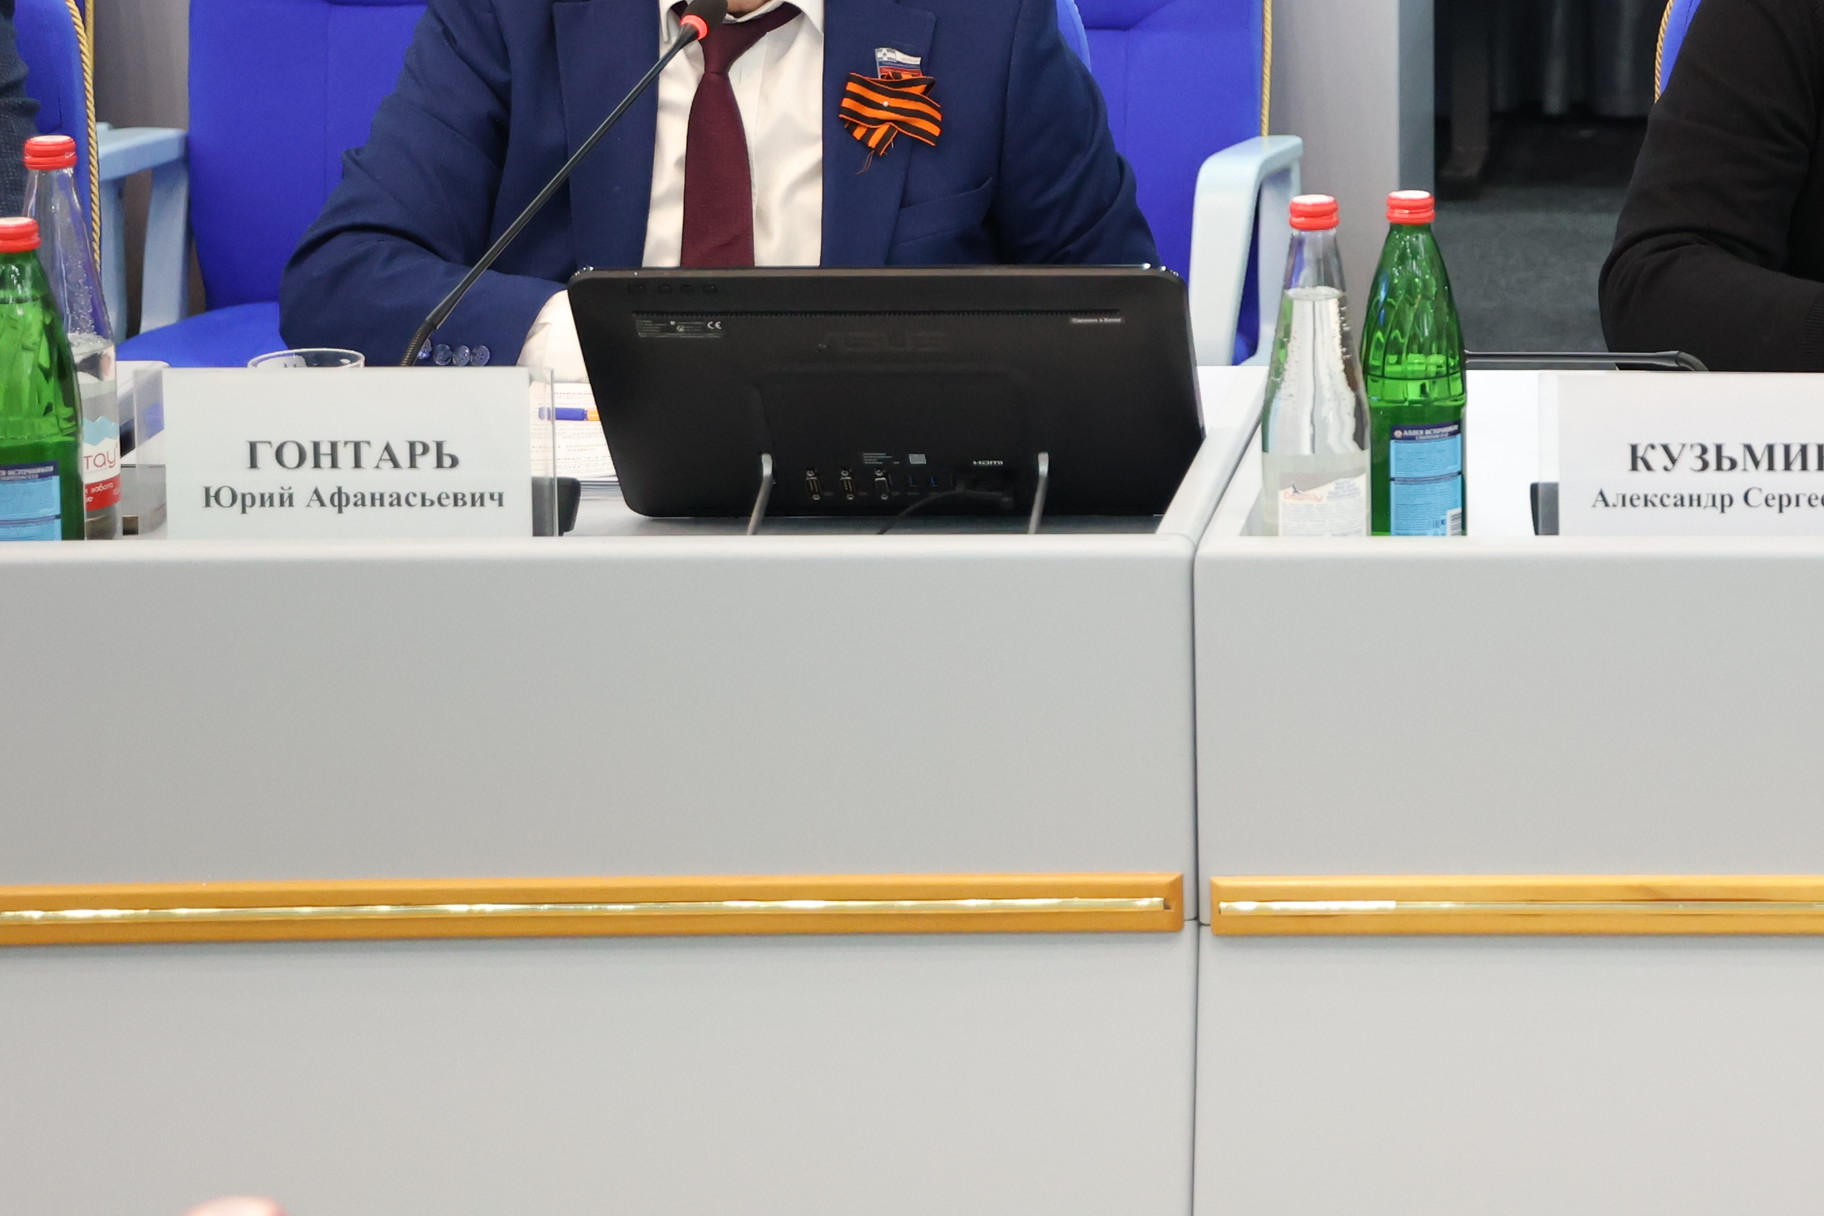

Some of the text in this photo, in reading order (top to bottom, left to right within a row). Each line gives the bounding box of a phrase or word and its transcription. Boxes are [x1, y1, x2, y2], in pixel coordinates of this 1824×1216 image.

[246, 439, 461, 470] ГОНТАРЬ
[202, 484, 506, 515] Юрий Афанасьевич
[1591, 487, 1735, 514] Александр
